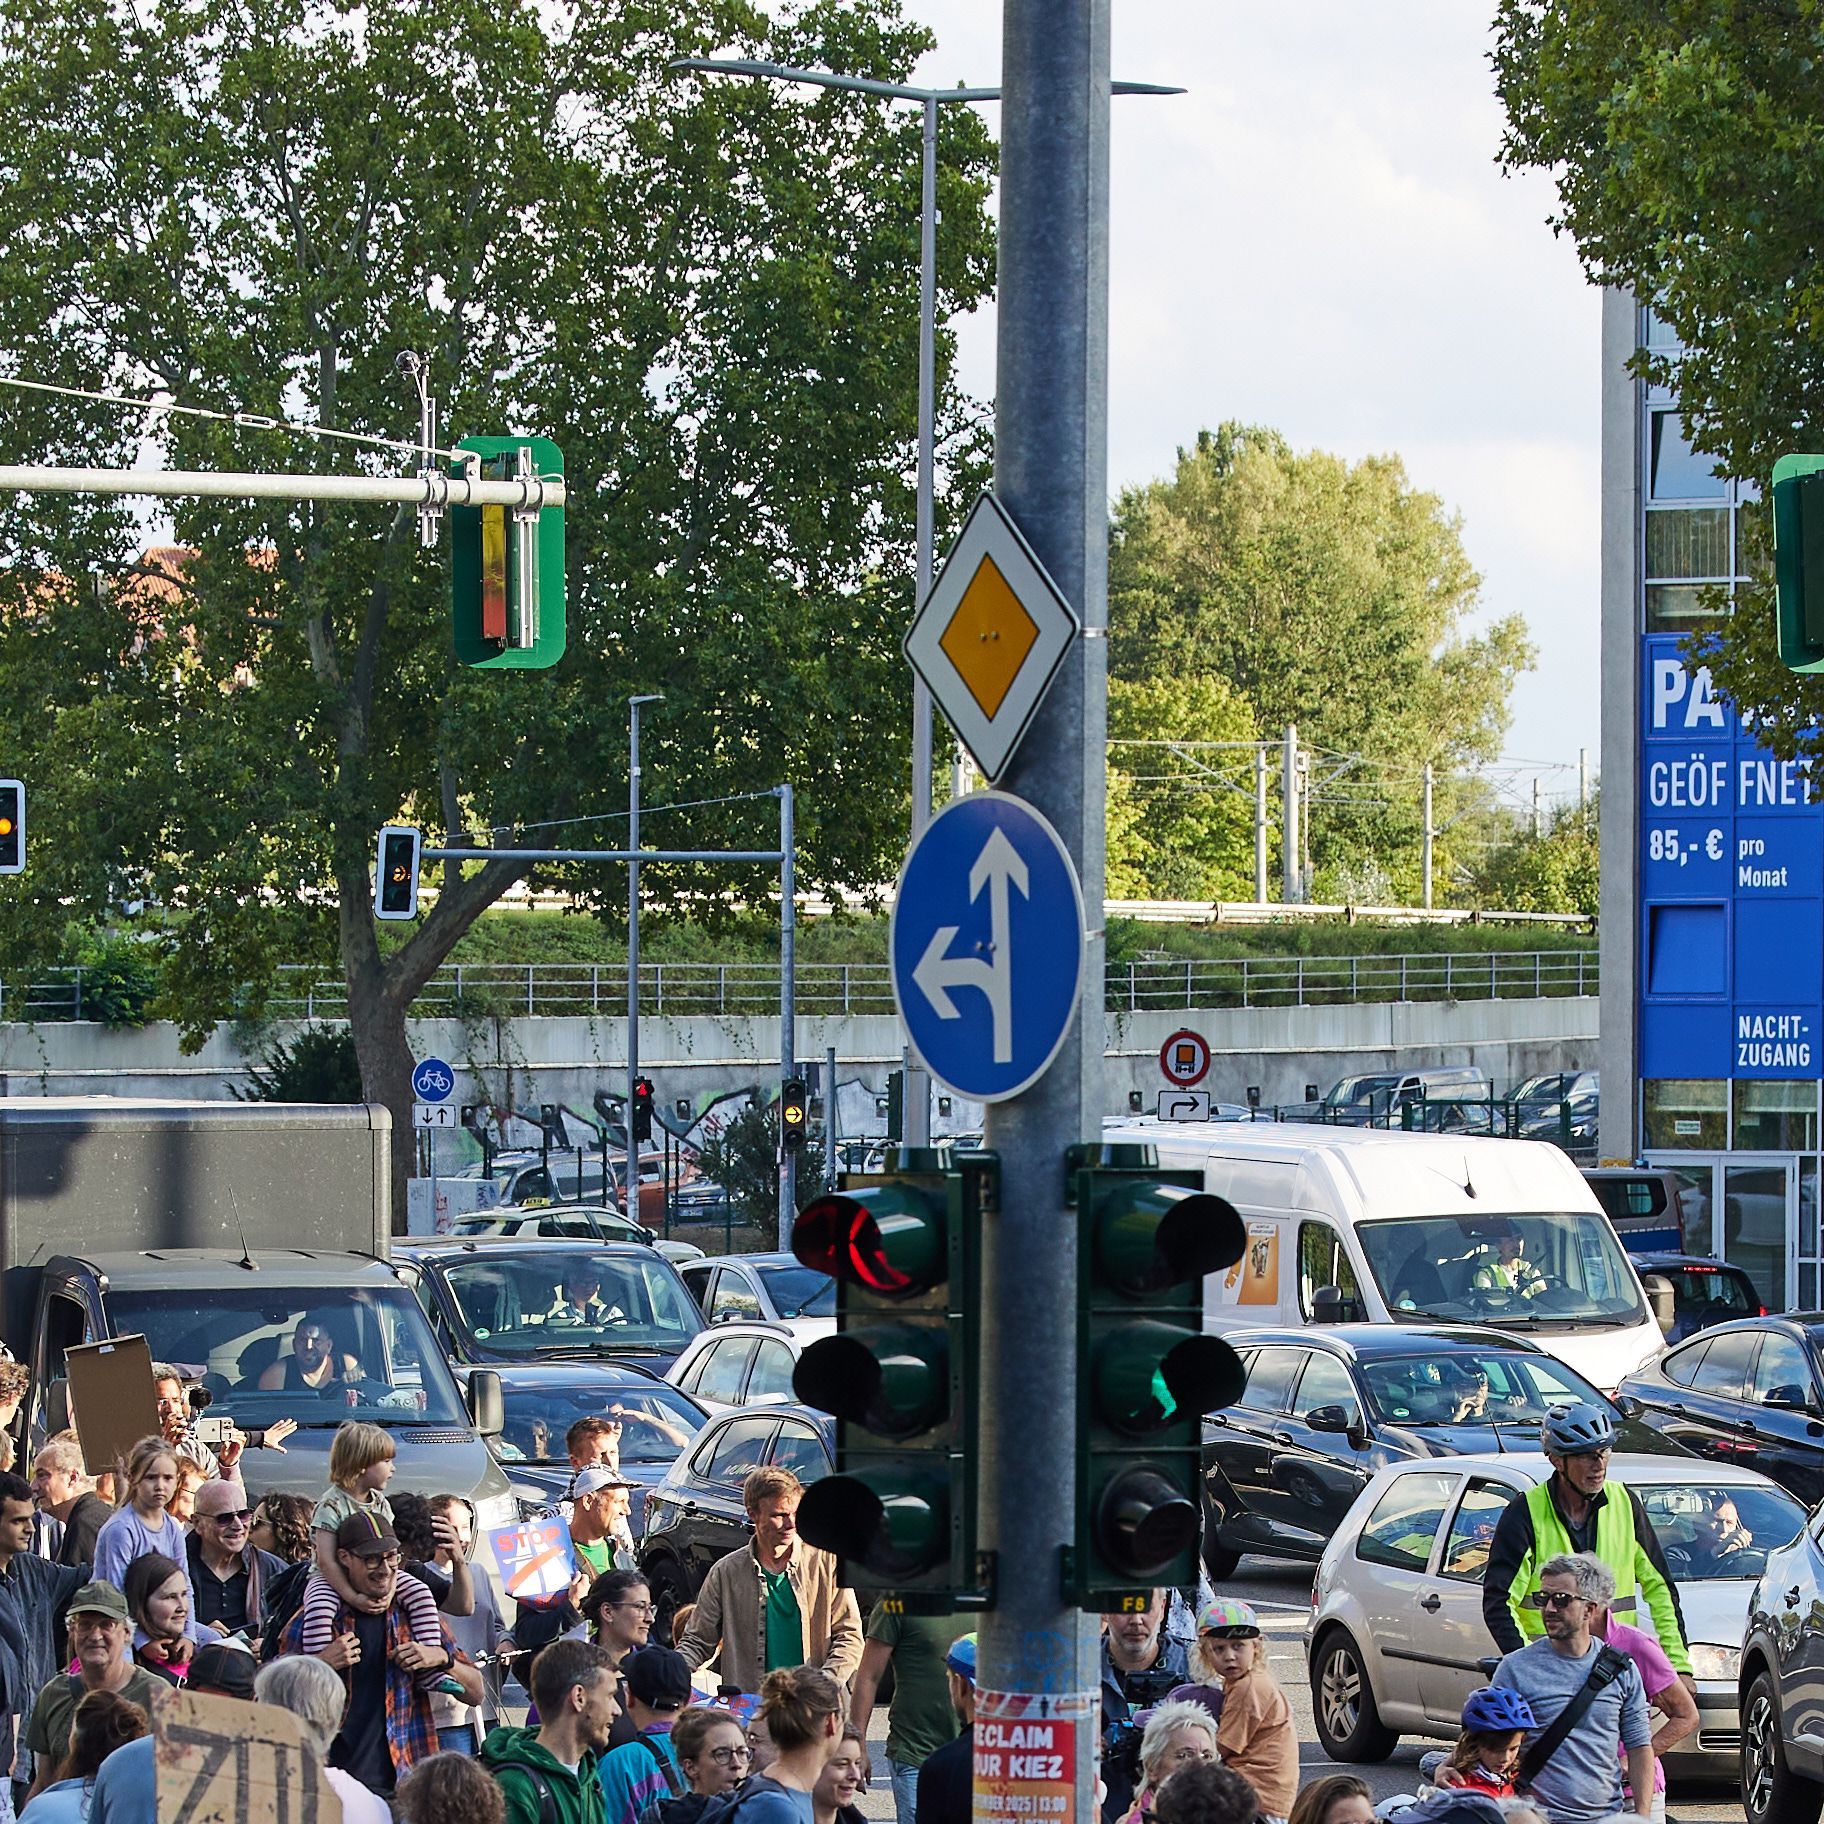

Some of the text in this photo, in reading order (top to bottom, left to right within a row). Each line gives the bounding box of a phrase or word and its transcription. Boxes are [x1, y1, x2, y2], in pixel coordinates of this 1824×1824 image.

[1649, 829, 1724, 867] 85,- €
[1739, 839, 1765, 860] pro
[1738, 865, 1788, 887] Monat
[1738, 1015, 1809, 1039] NACHT-
[1737, 1043, 1810, 1067] ZUGANG
[498, 1525, 561, 1552] STOP
[1009, 1754, 1064, 1779] KIEZ
